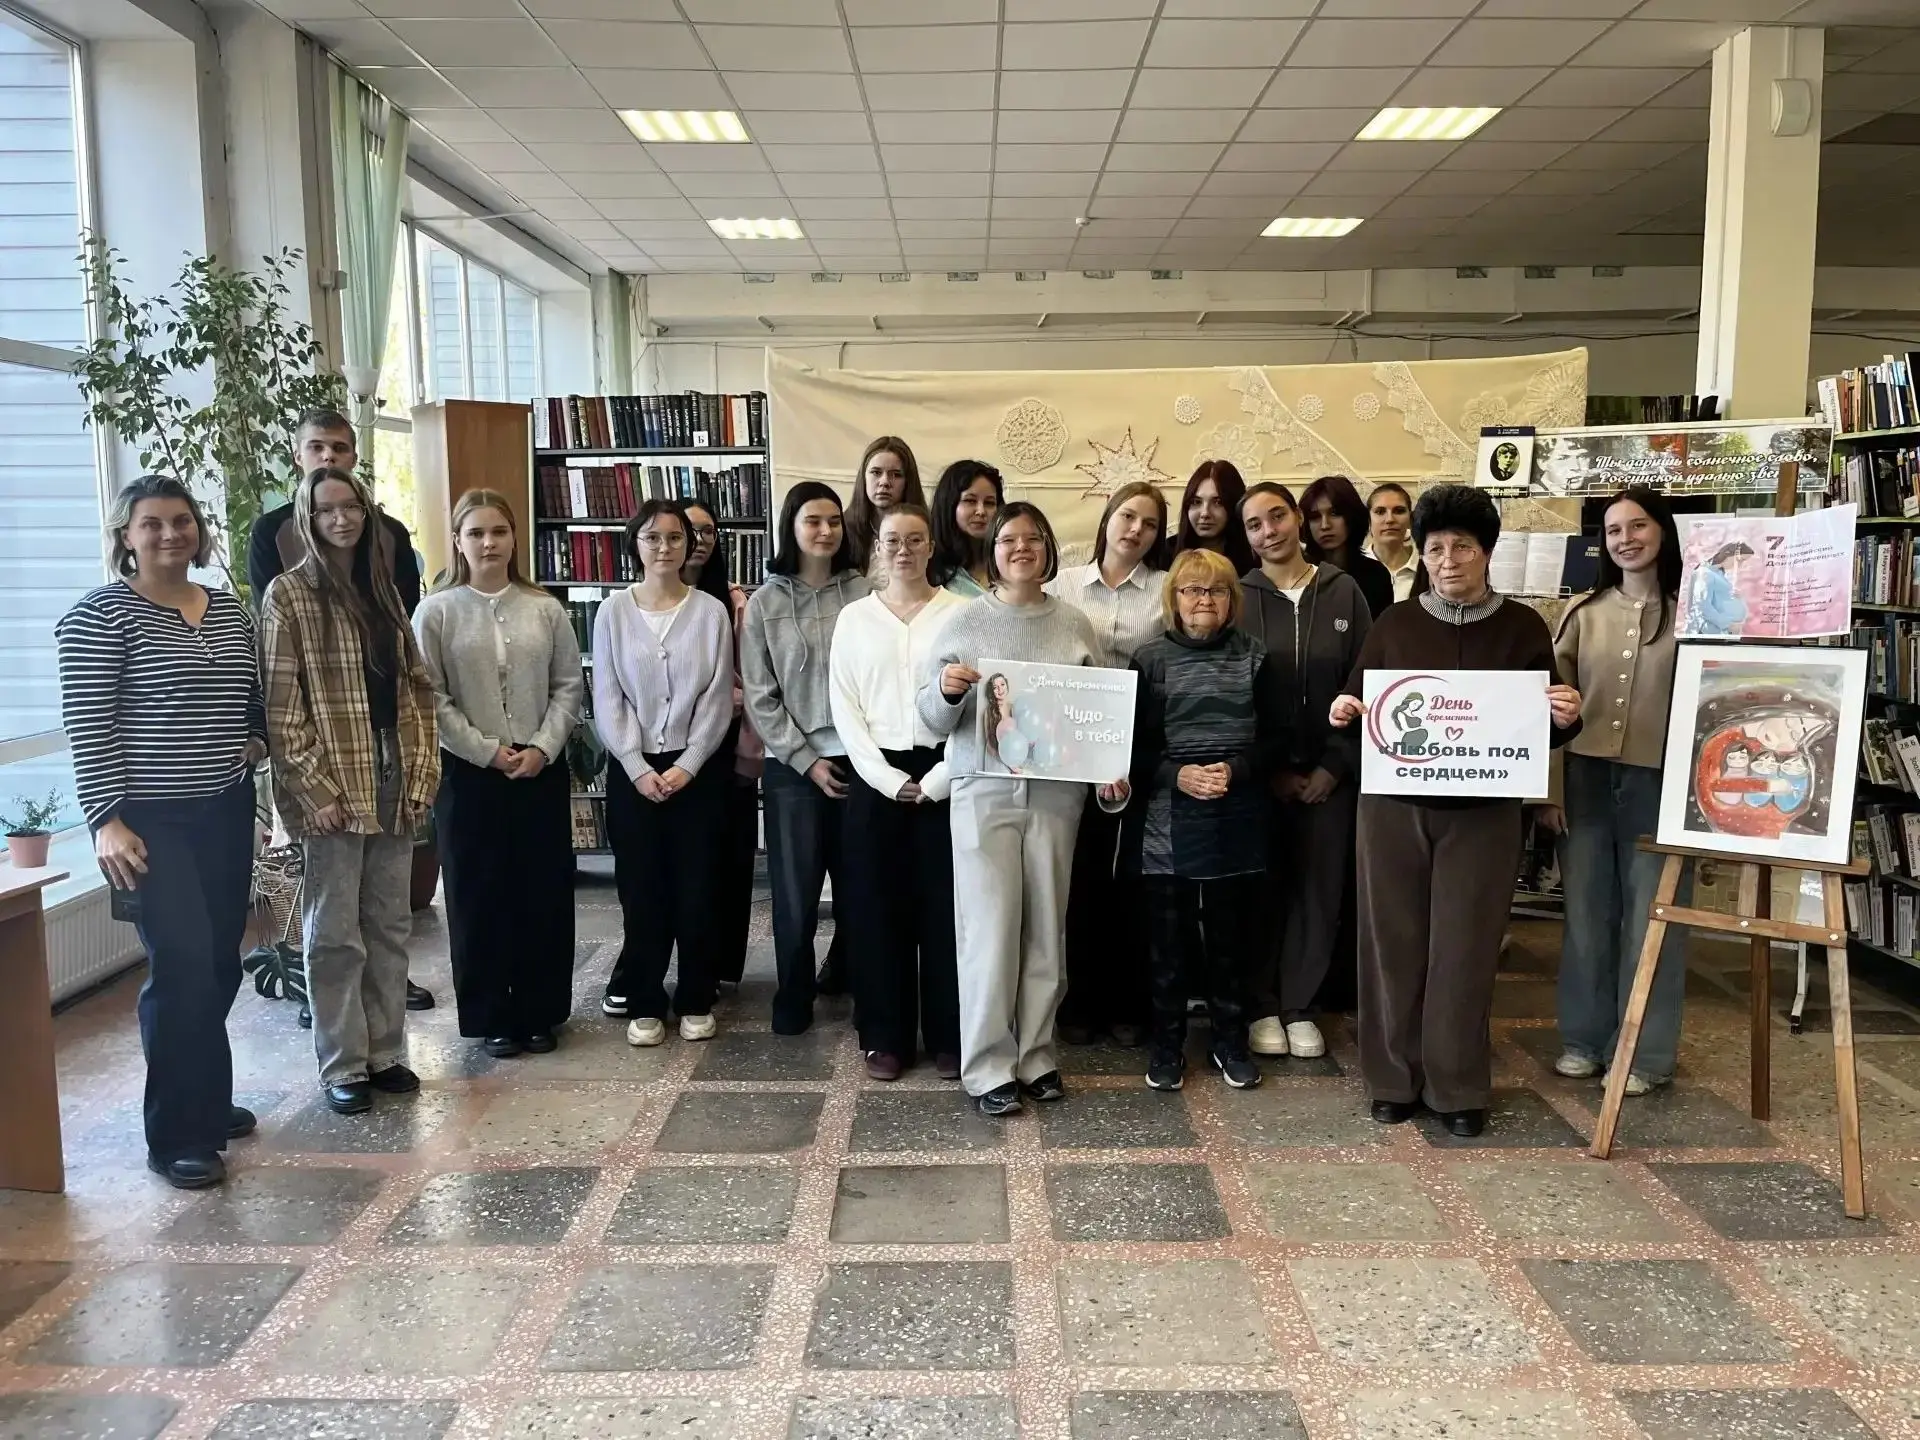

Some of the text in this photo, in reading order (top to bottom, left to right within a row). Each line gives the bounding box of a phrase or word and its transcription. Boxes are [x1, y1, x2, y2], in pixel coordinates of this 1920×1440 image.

[1595, 449, 1818, 471] Ты даришь солнечное слово,
[1600, 471, 1684, 484] Российской
[1686, 471, 1745, 486] удалью
[1766, 536, 1785, 550] 7
[1430, 694, 1473, 711] День
[1064, 704, 1103, 724] Чудо
[1425, 712, 1478, 723] беременных
[1074, 729, 1126, 744] в тебе!
[1378, 741, 1530, 761] «Любовь под
[1395, 767, 1509, 782] сердцем»
